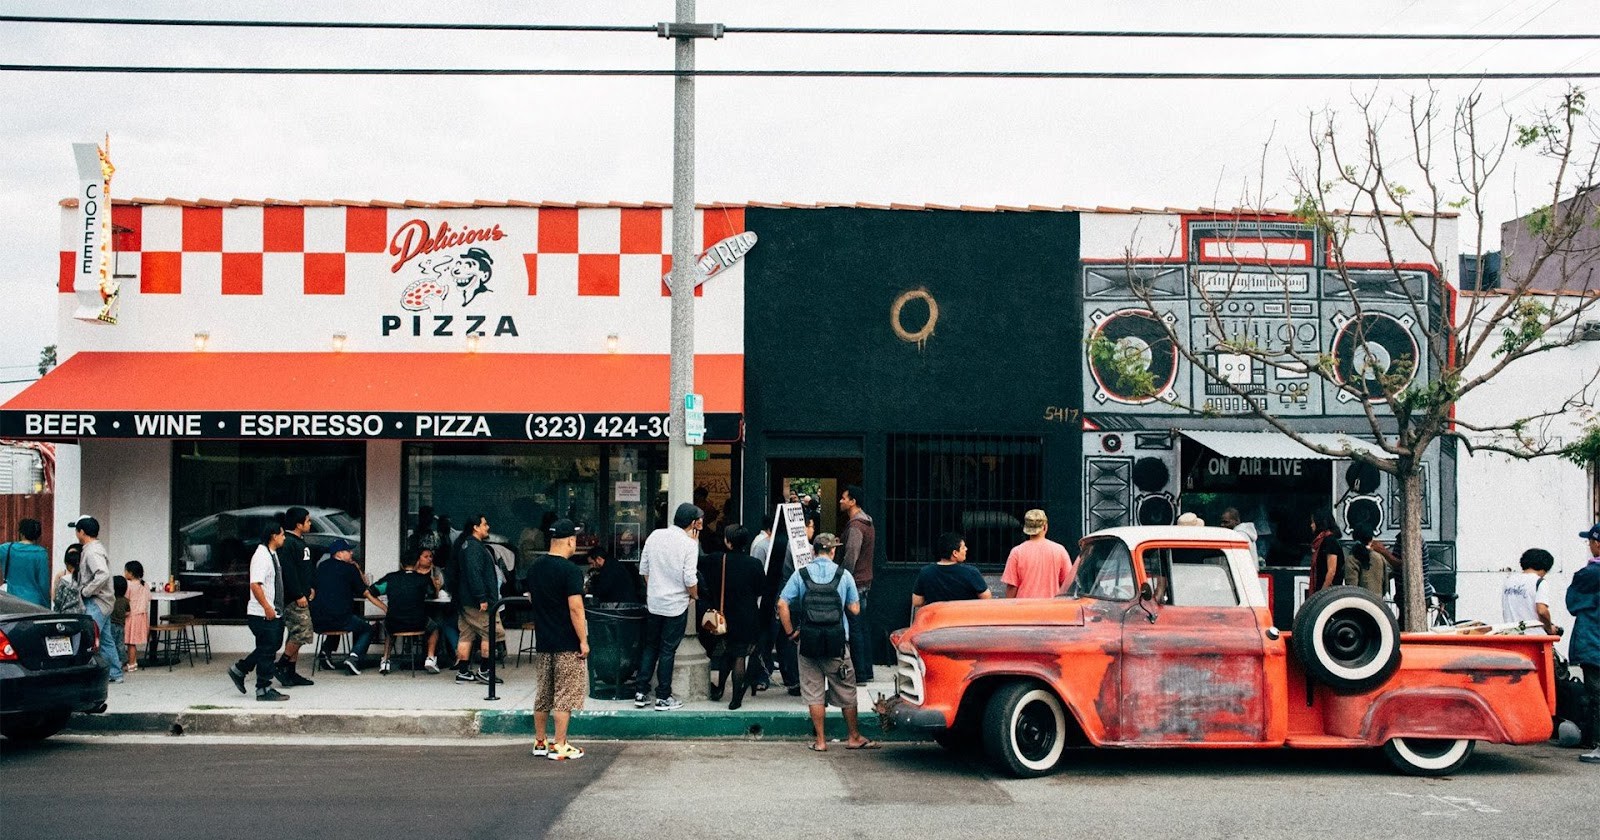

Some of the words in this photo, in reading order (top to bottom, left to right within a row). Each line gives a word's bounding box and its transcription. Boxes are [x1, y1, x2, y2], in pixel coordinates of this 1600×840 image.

[82, 184, 97, 274] COFFEE
[389, 218, 508, 274] Delicious
[714, 233, 756, 268] REAR
[382, 315, 519, 337] PIZZA
[25, 414, 97, 435] BEER
[134, 414, 202, 436] WINE
[240, 414, 384, 436] ESPRESSO
[415, 415, 492, 437] PIZZA
[525, 413, 586, 440] (323)
[1043, 406, 1079, 423] 5417
[1208, 457, 1230, 476] ON
[1239, 457, 1262, 476] AIR
[1269, 459, 1303, 476] LIVE
